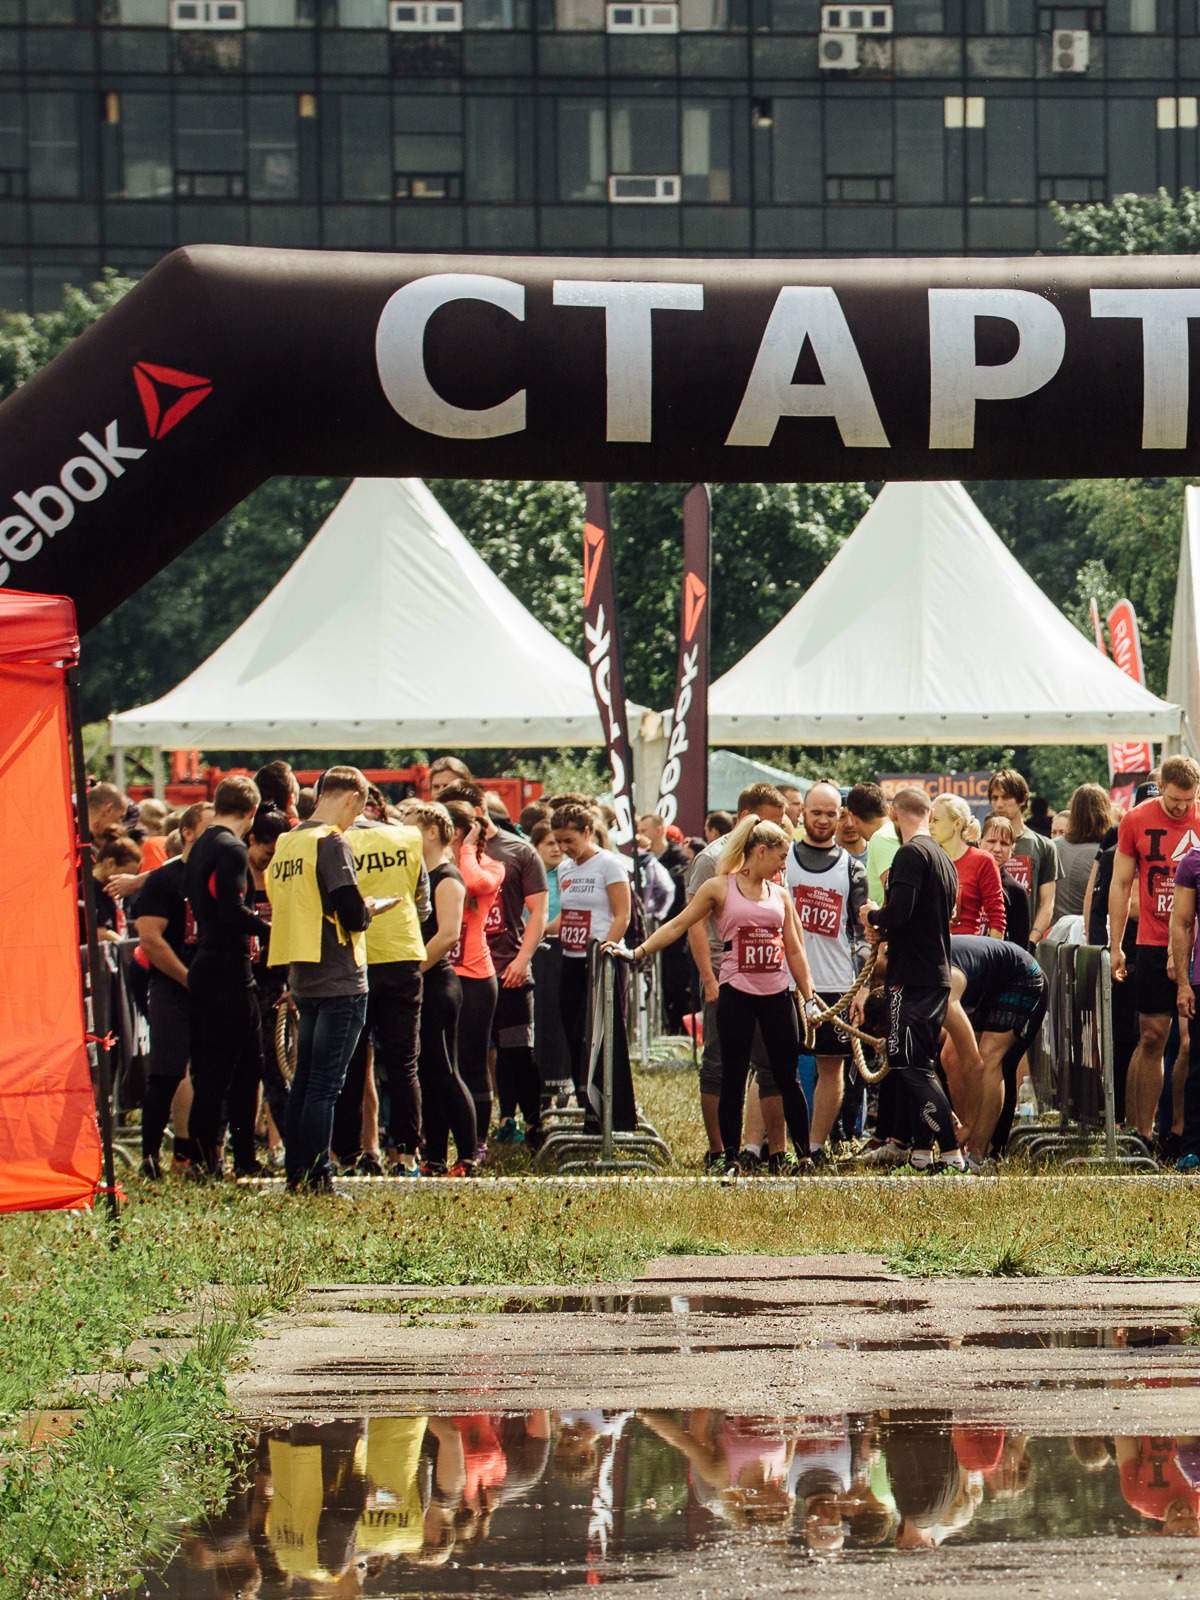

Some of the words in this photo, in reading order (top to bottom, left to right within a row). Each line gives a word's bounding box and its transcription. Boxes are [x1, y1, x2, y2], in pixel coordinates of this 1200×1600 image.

[0, 419, 148, 586] ebok
[655, 643, 699, 827] eebok
[354, 850, 408, 873] УДЬЯ
[1158, 894, 1175, 912] R2
[801, 904, 837, 929] R192
[561, 926, 588, 944] R232
[745, 945, 782, 964] R192
